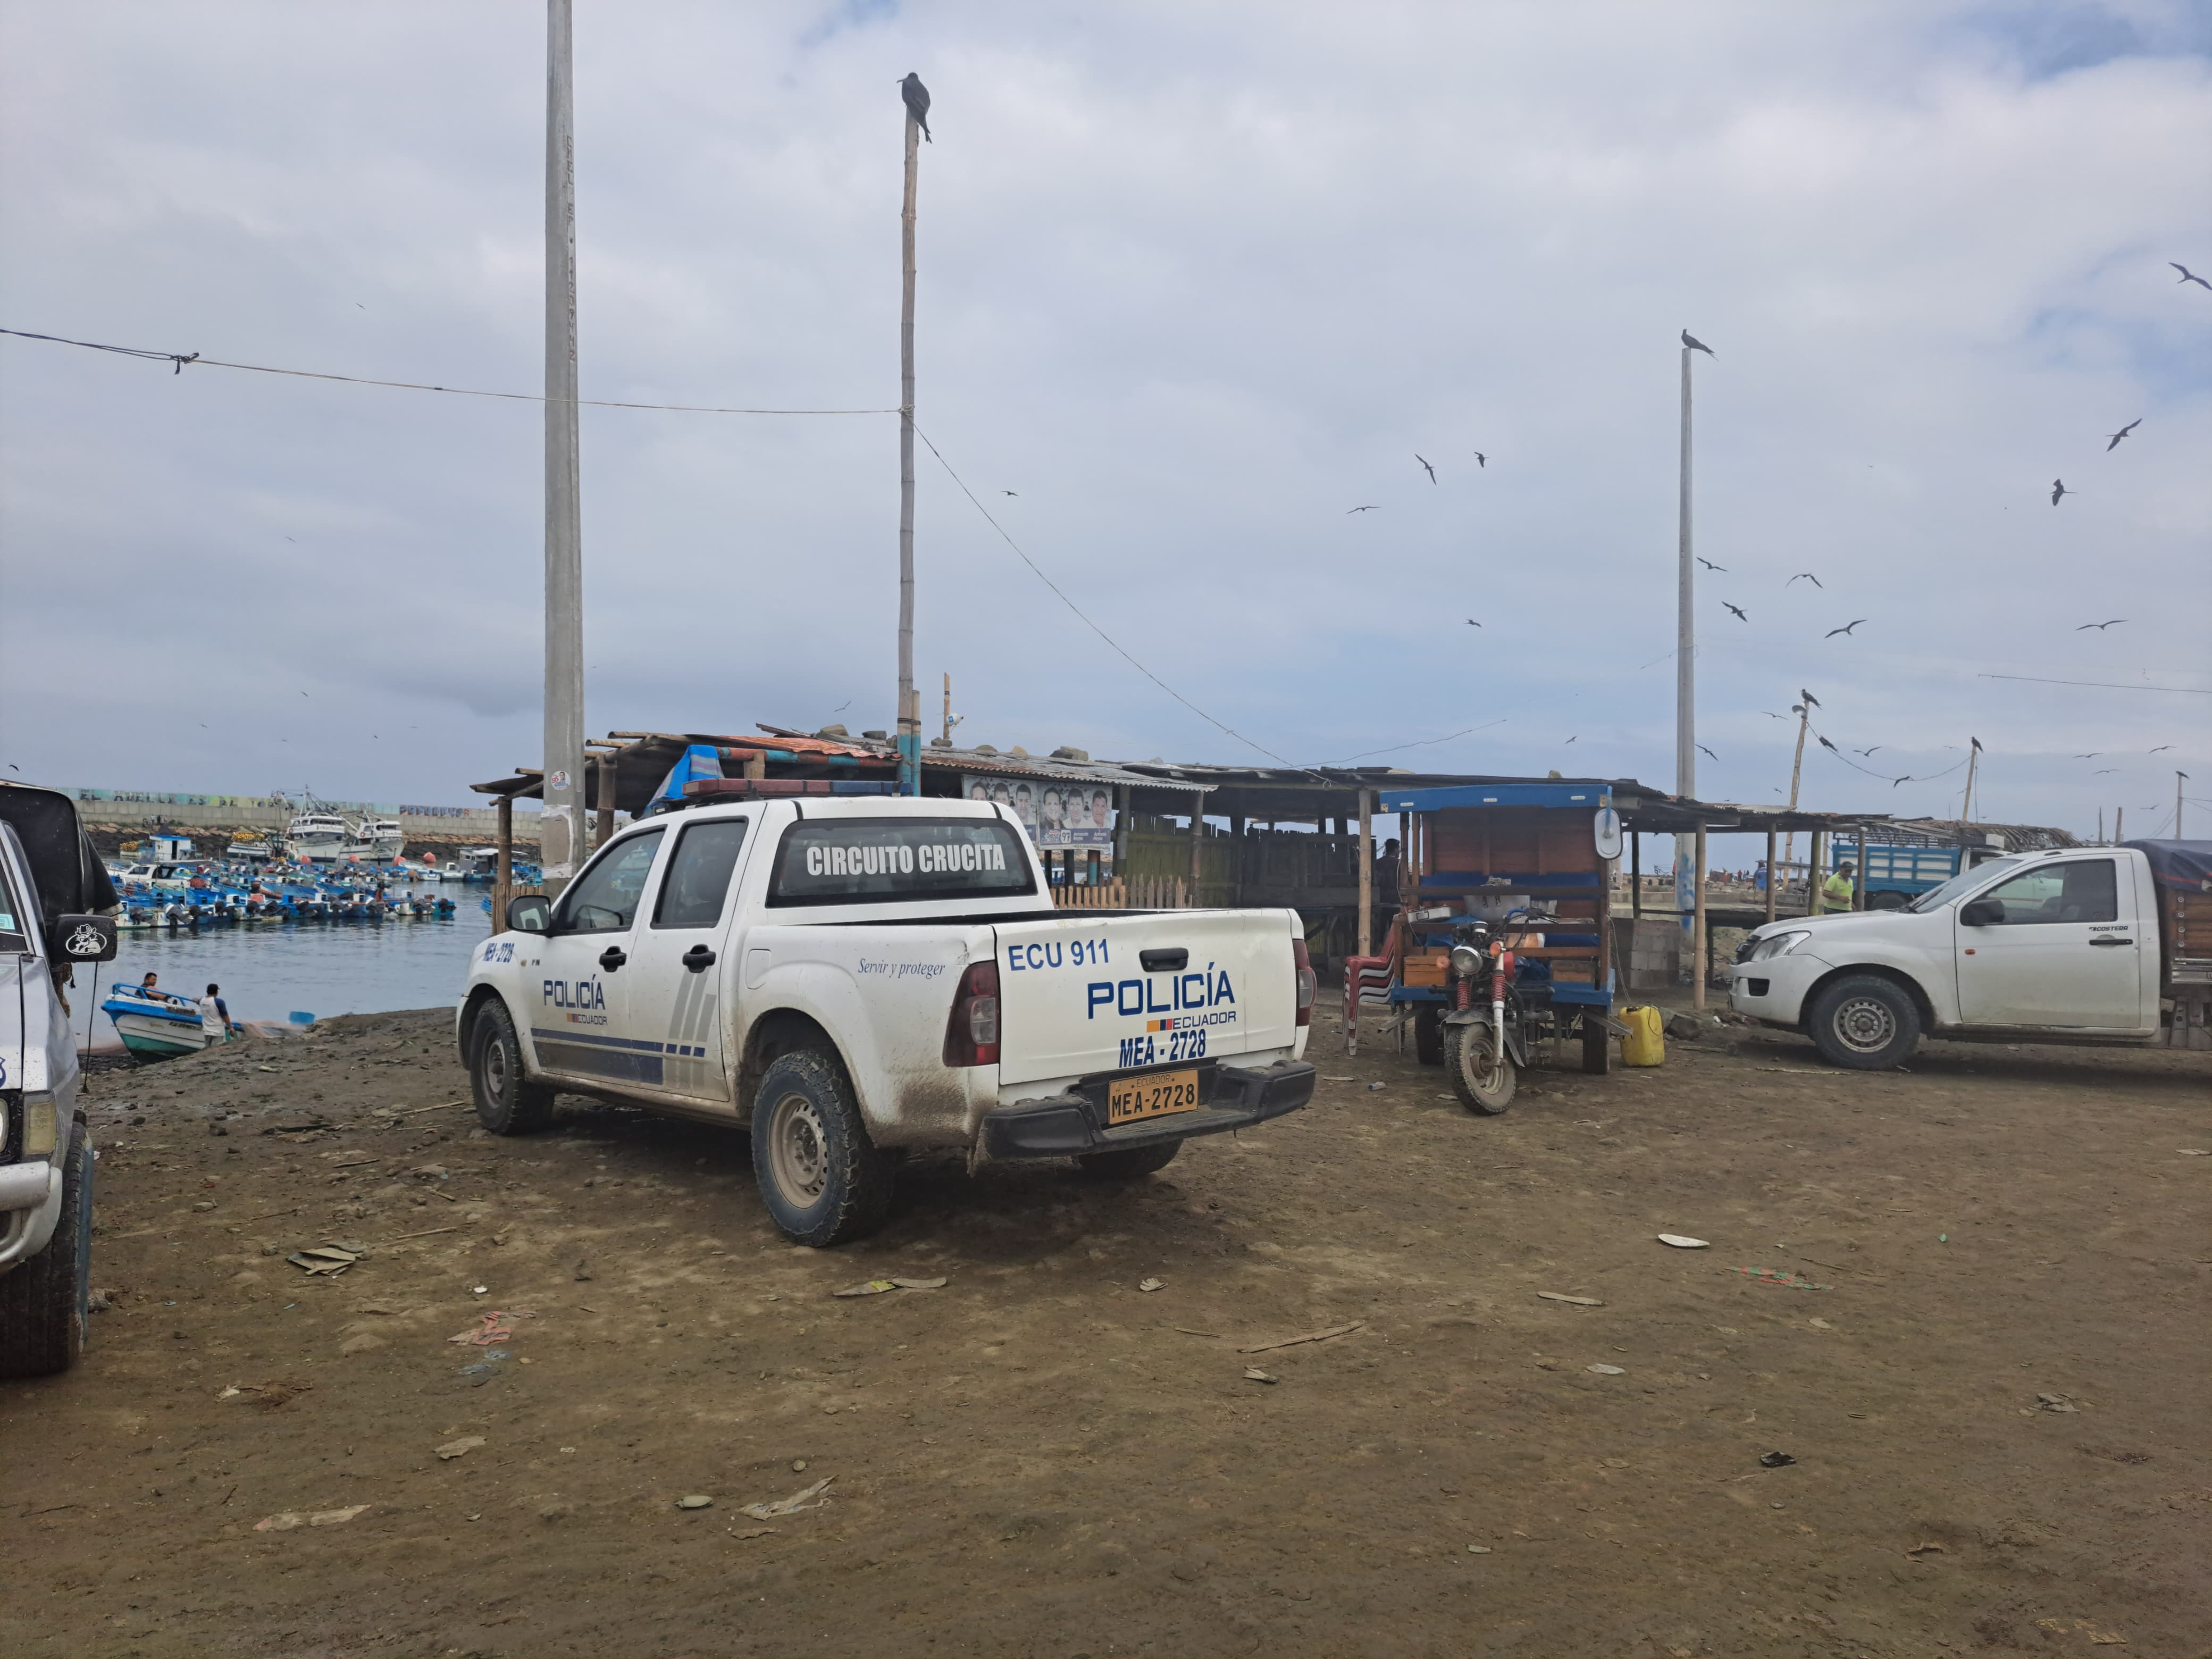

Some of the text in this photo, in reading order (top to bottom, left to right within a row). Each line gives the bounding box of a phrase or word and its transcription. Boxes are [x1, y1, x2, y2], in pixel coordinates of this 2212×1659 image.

[1062, 832, 1070, 842] 97
[807, 844, 1006, 876] CIRCUITO CRUCITA
[858, 958, 945, 979] Servir y proteger
[1009, 939, 1109, 971] ECU 911
[543, 974, 605, 1010] POLICÍA
[1087, 962, 1235, 1019] POLICÍA
[577, 1014, 608, 1026] ECUADOR
[1173, 1011, 1236, 1030] ECUADOR
[1119, 1036, 1154, 1068] MEA
[1170, 1029, 1206, 1061] 2728
[1137, 1074, 1170, 1087] ECUADOR
[1112, 1084, 1195, 1118] MEA-2728
